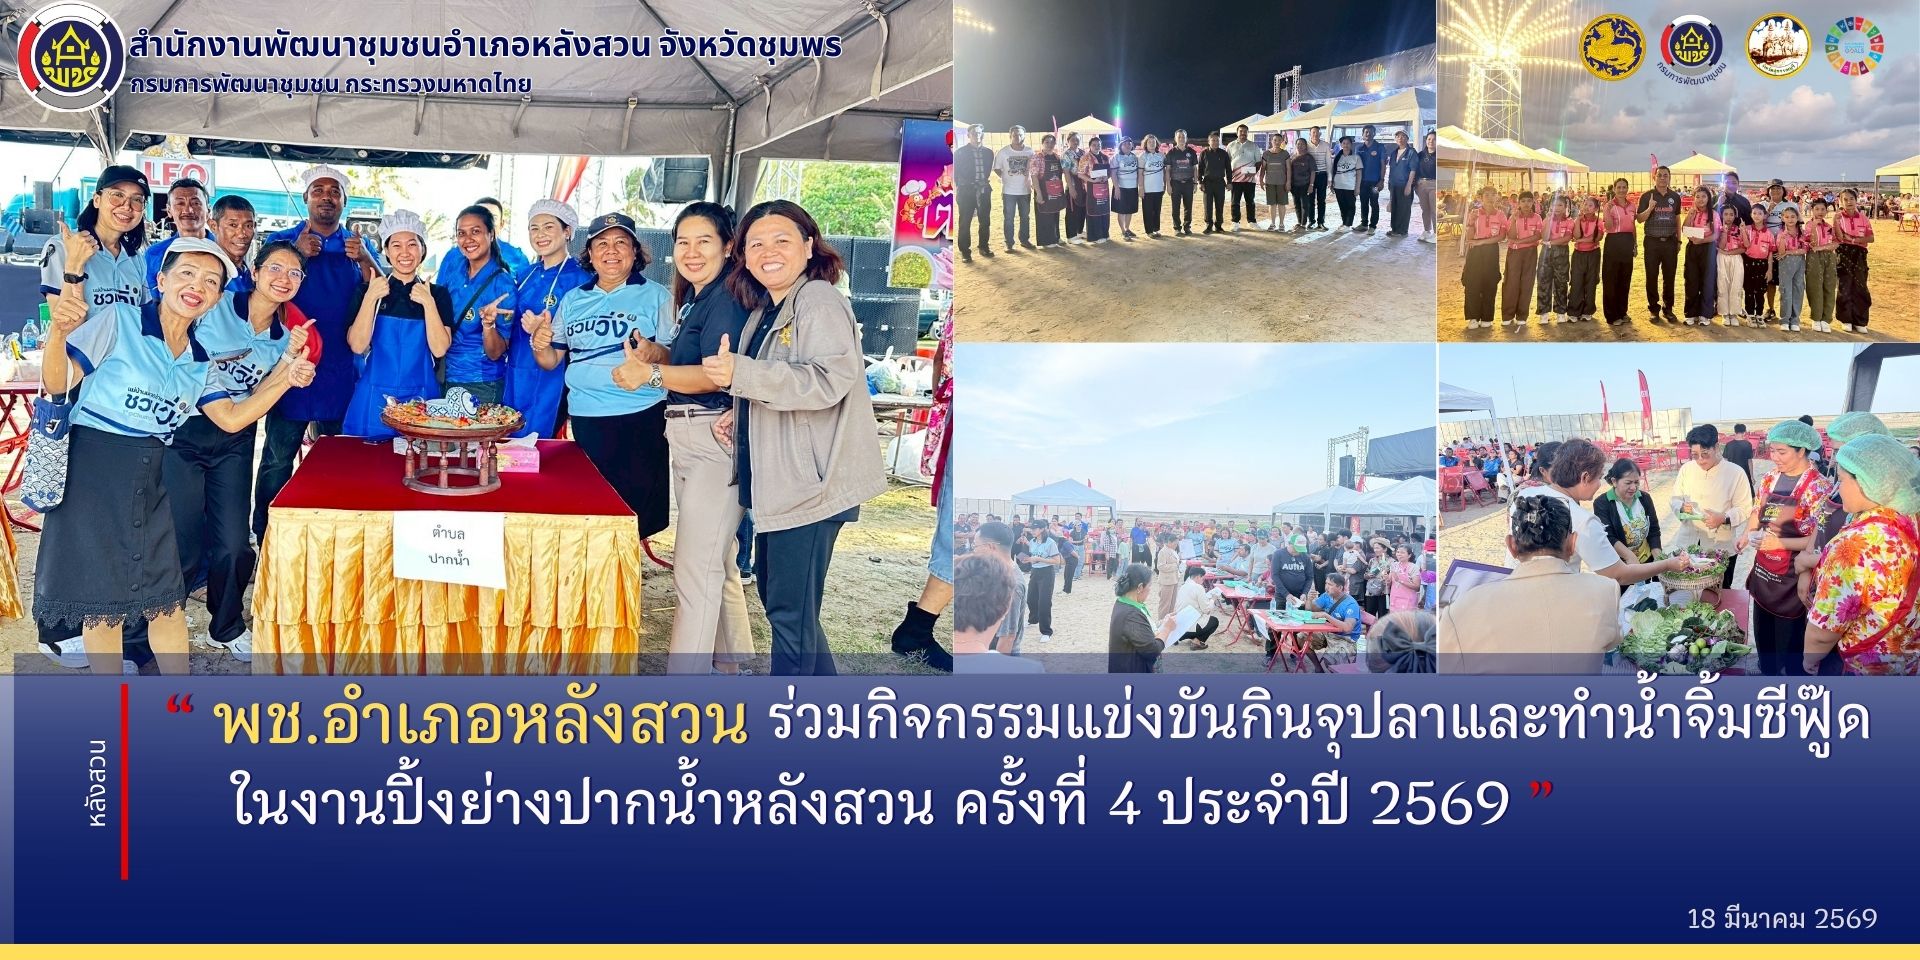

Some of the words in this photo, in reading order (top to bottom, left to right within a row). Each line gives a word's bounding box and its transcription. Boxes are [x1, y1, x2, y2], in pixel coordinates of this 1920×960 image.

[432, 523, 466, 540] ตำบล
[428, 548, 470, 567] ปากน้ำ
